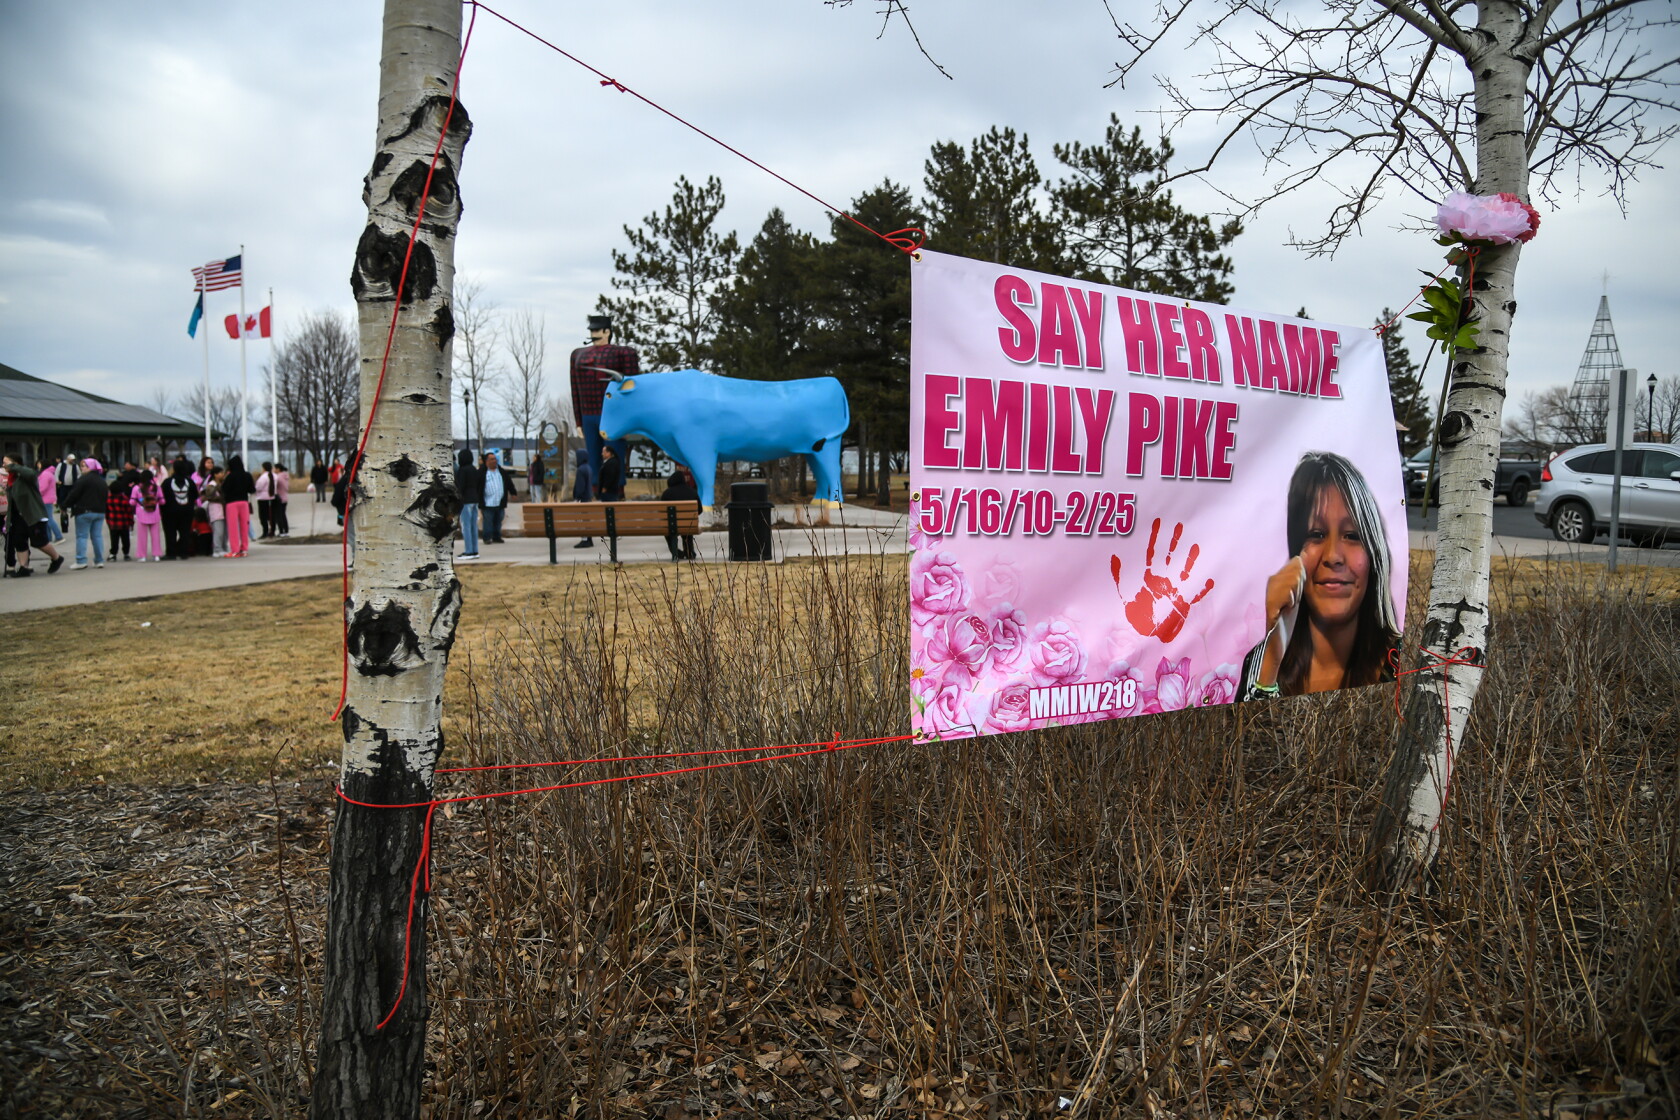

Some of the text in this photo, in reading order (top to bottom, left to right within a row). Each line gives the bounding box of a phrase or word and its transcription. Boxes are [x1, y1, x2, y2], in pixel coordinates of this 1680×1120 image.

[993, 274, 1342, 399] SAY HER NAME
[923, 374, 1239, 480] EMILY PIKE
[919, 486, 1136, 536] 5/16/10-2/25
[1028, 680, 1137, 720] MMIW218
